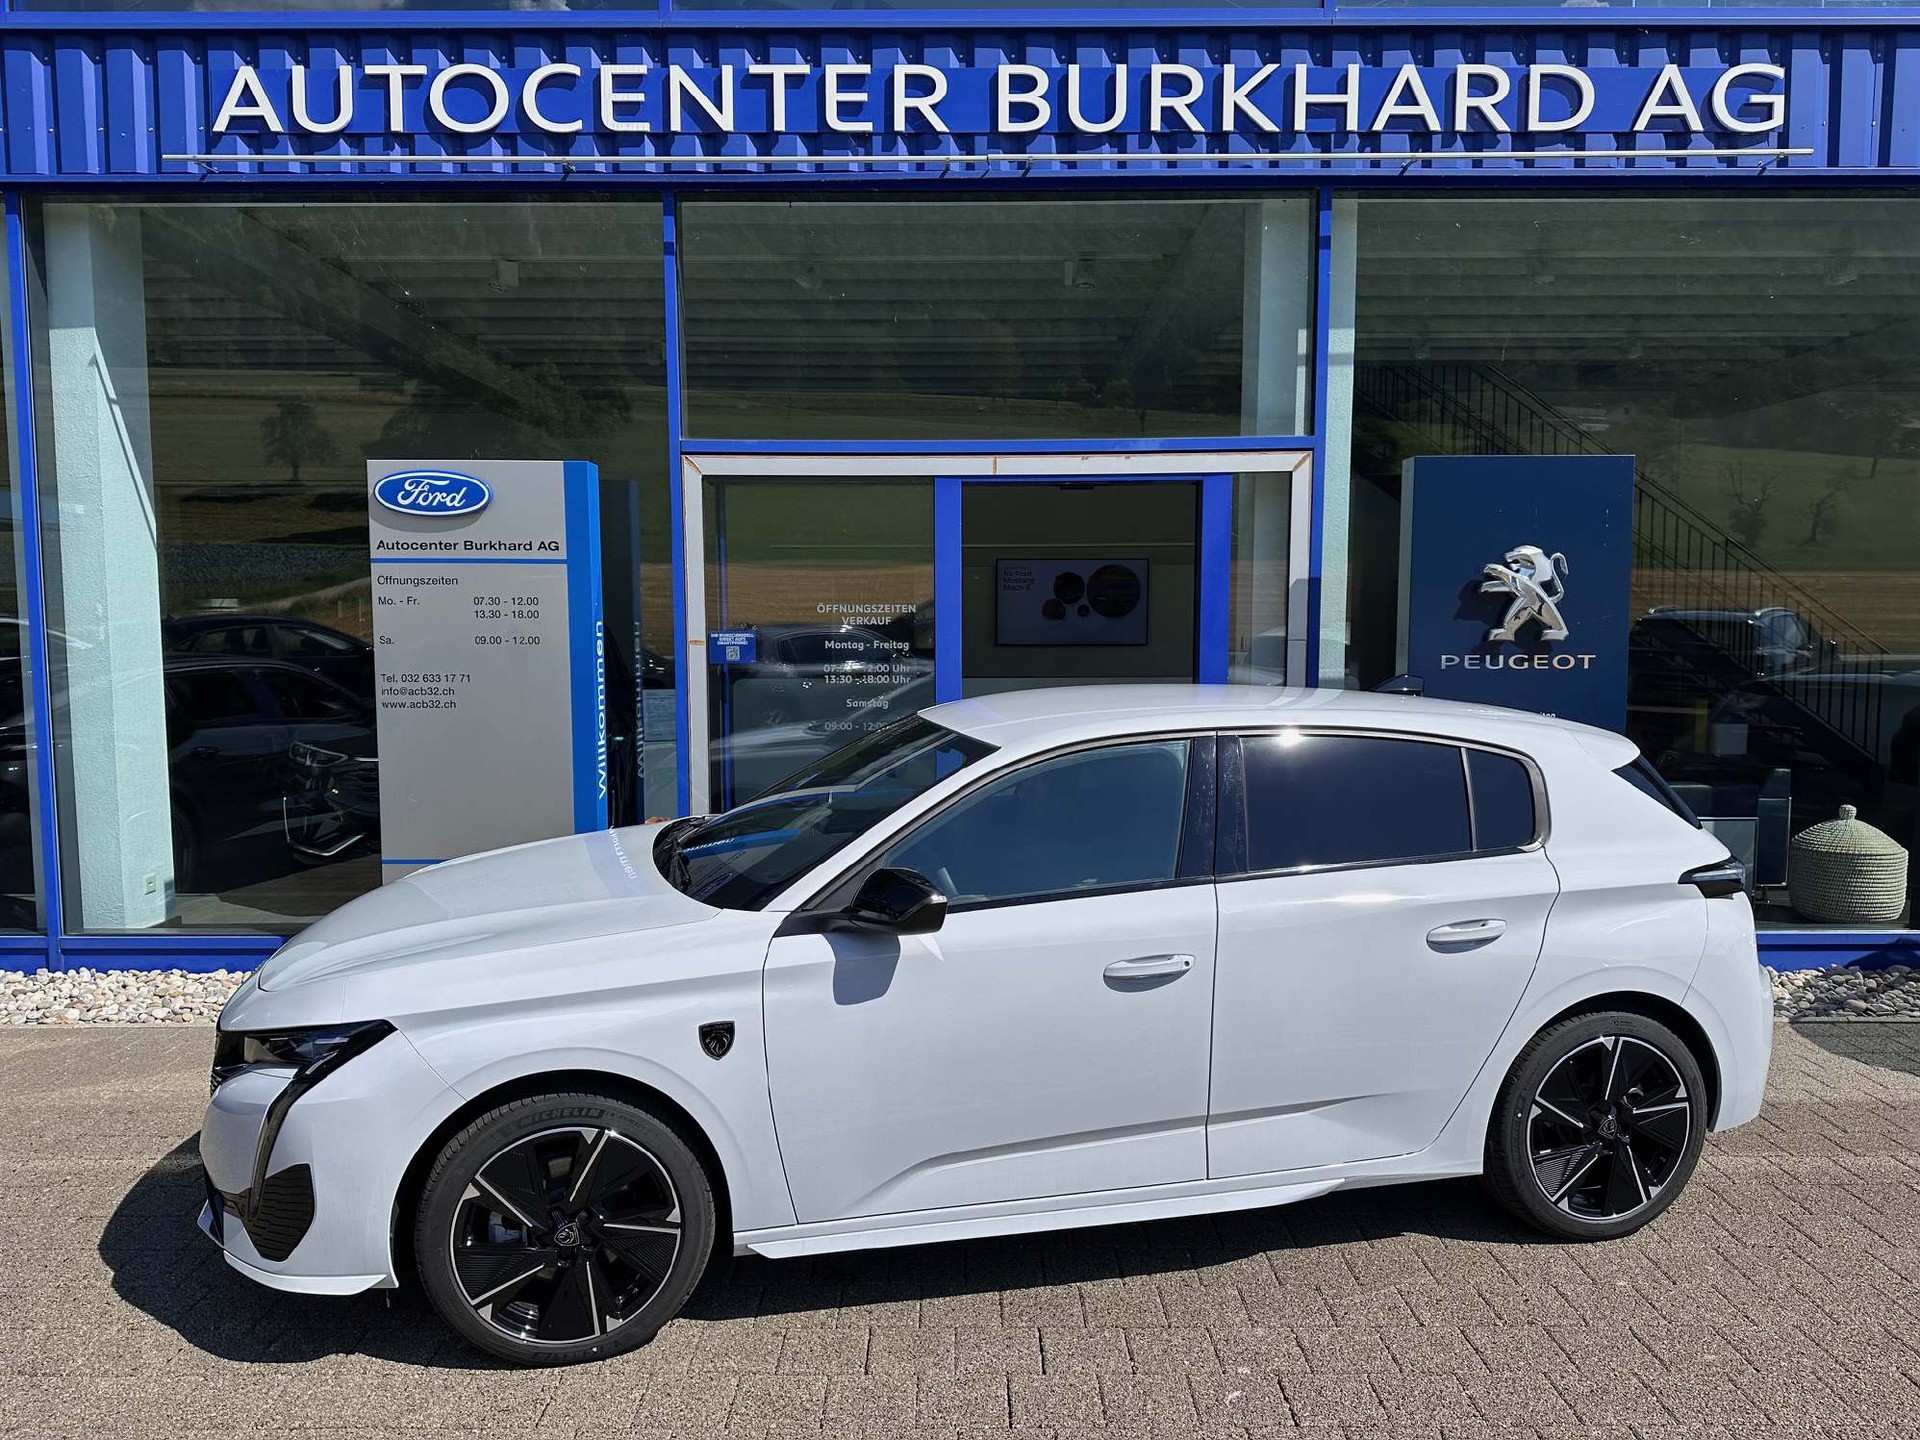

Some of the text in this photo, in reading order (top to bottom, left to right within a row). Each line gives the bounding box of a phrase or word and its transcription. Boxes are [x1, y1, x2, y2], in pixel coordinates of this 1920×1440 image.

[212, 63, 1785, 133] AUTOCENTER BURKHARD AG
[397, 478, 467, 507] Ford
[376, 540, 560, 552] Autocenter Burkhard AG
[378, 596, 396, 606] Mo.
[406, 596, 420, 606] Fr.
[473, 596, 501, 606] 07.30
[511, 596, 539, 606] 12.00
[816, 603, 917, 614] ÖFFNUNGSZEITEN
[475, 609, 501, 619] 13.30
[512, 609, 540, 619] 18.00
[842, 616, 892, 626] VERKAUF
[379, 635, 395, 645] Sa.
[474, 635, 502, 645] 09.00
[513, 635, 541, 645] 12.00
[824, 640, 864, 651] Montag
[873, 640, 910, 651] Freitag
[1440, 654, 1597, 670] PEUGEOT
[892, 664, 910, 673] Uhr
[380, 673, 471, 683] Tel. 032 633 17 71
[824, 675, 853, 684] 13:30
[863, 675, 890, 684] 18:00
[892, 675, 911, 684] Uhr
[381, 686, 455, 697] info@acb32.ch
[381, 699, 457, 709] www.acb32.ch
[846, 699, 889, 709] Samstag
[594, 621, 606, 800] Willkommen
[824, 721, 853, 731] 09:00
[520, 1109, 601, 1127] MICHELIN
